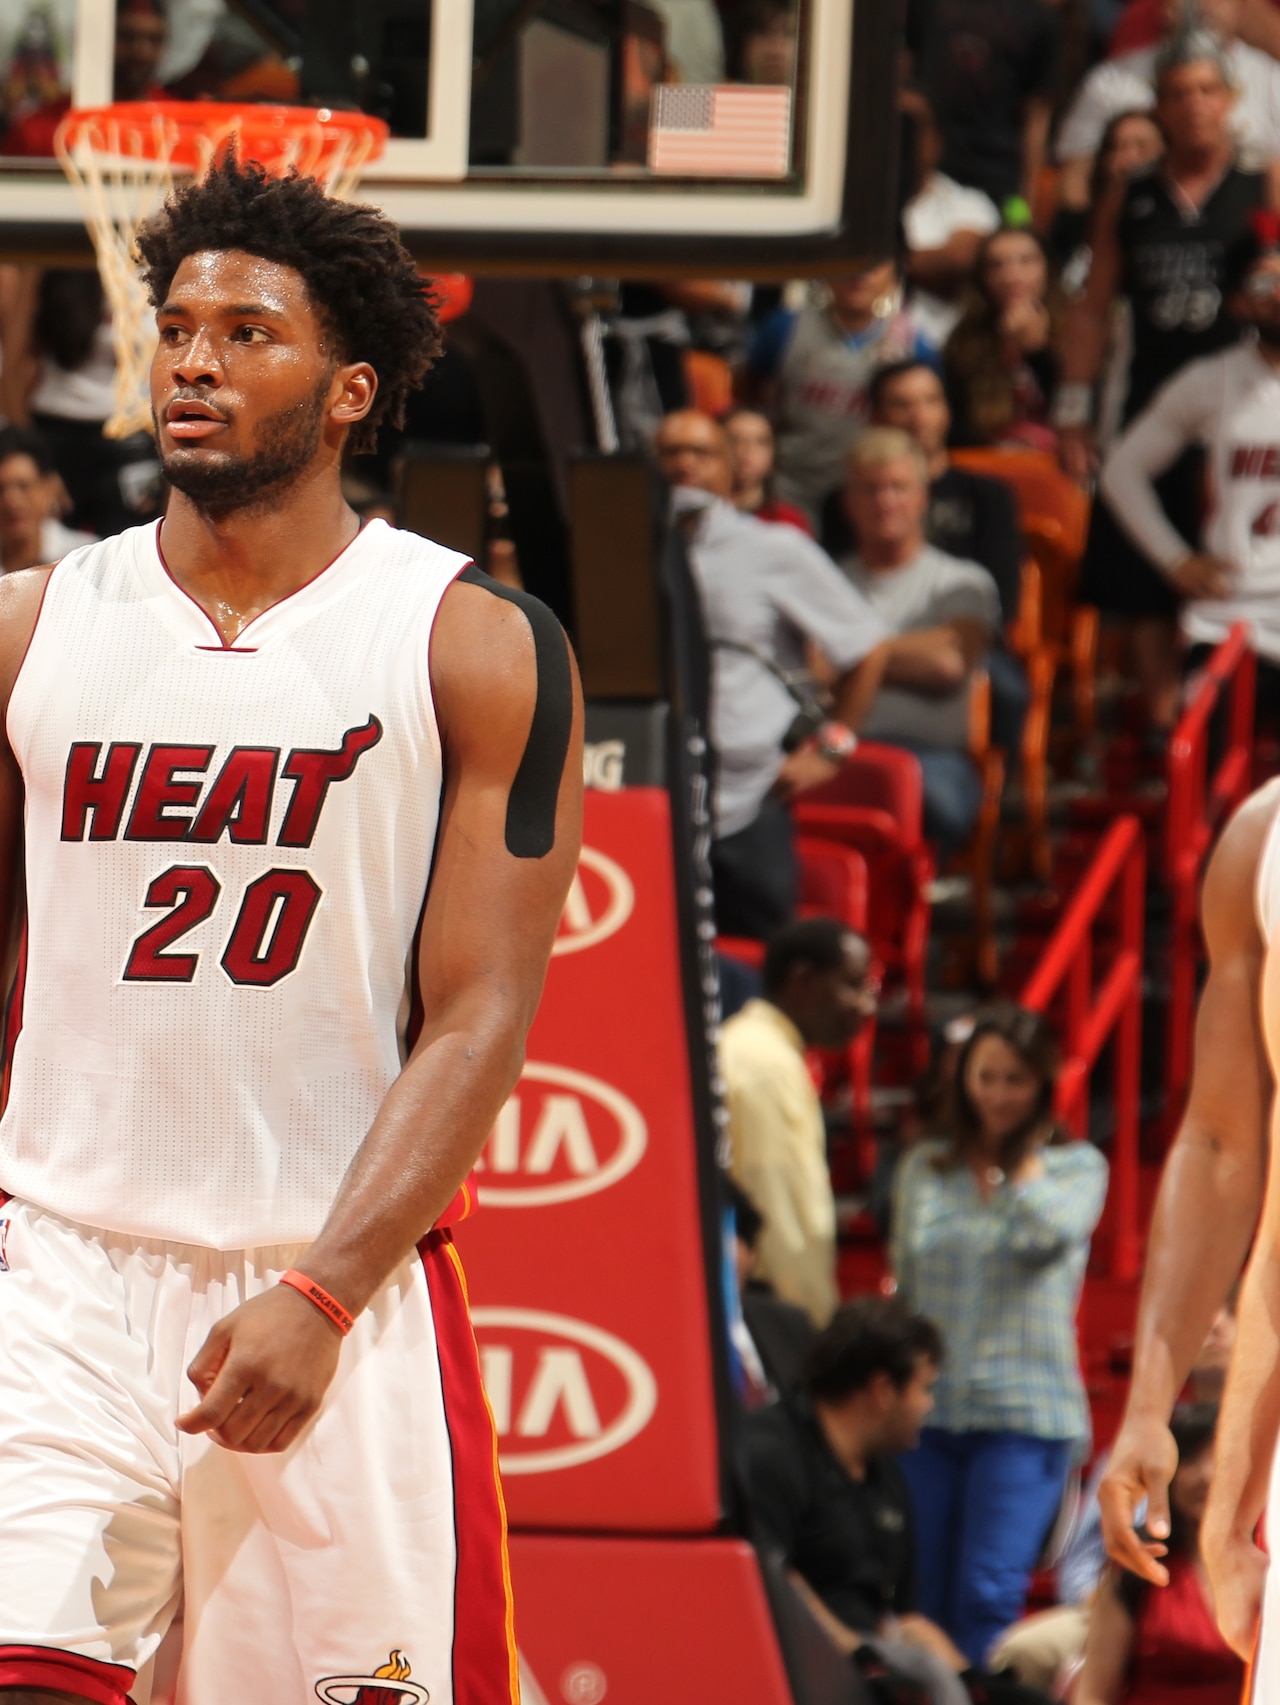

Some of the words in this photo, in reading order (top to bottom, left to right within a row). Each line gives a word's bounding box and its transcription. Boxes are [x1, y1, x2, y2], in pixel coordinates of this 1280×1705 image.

[60, 712, 383, 848] HEAT
[116, 861, 326, 991] 20
[474, 1092, 600, 1176] IA
